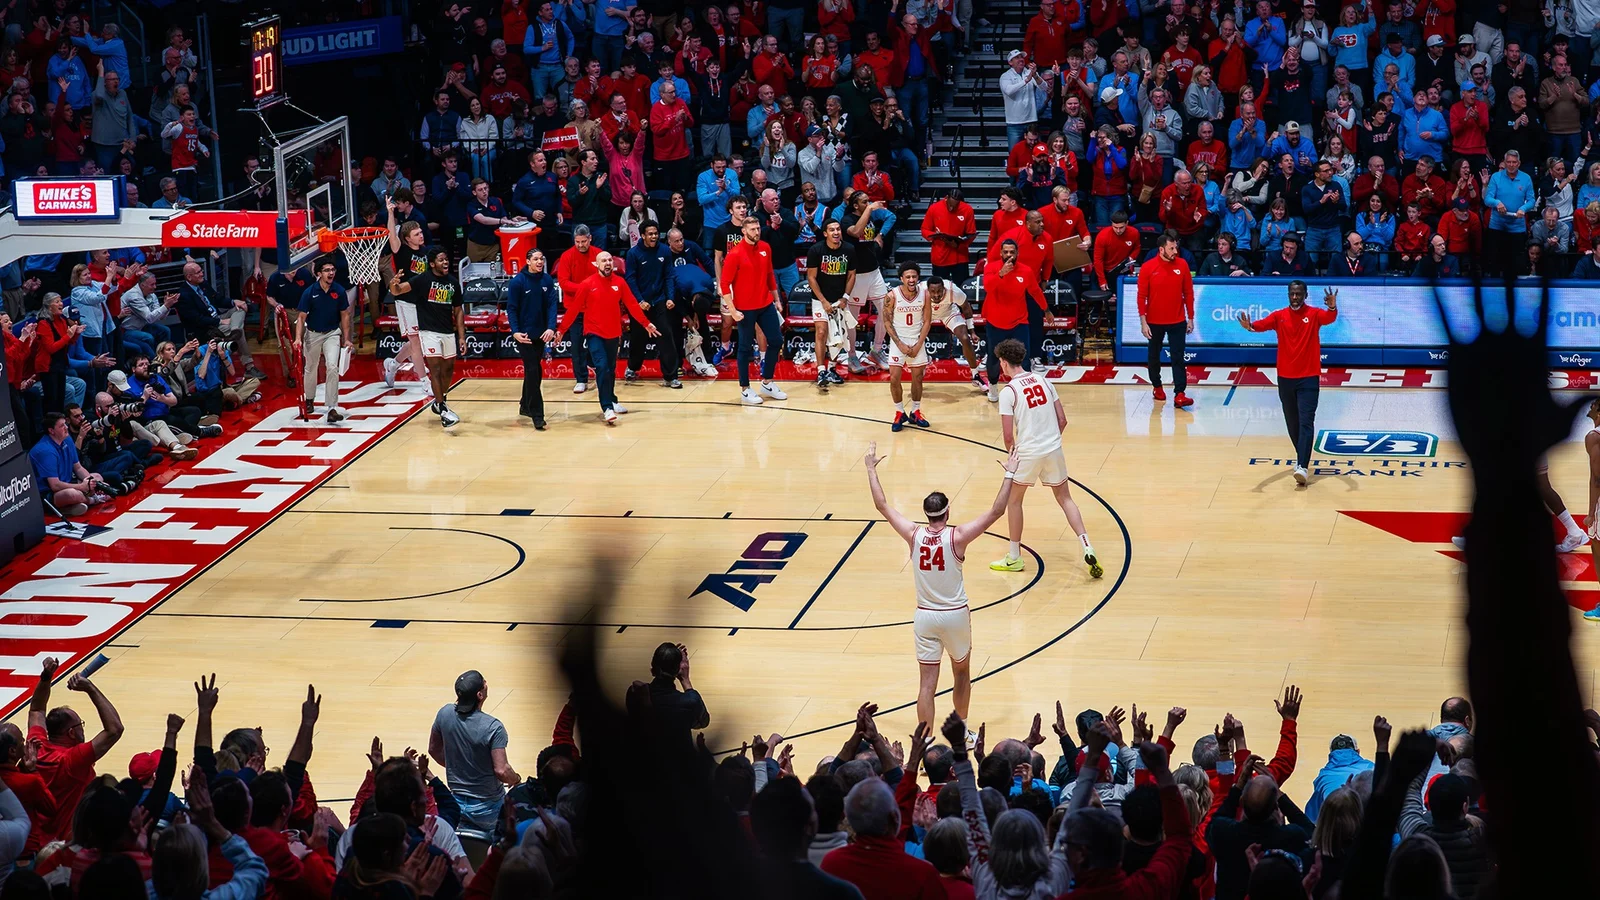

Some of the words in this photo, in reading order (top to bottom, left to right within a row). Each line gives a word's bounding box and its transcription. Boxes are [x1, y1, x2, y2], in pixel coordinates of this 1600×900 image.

[282, 37, 315, 56] BUD
[318, 29, 376, 51] LIGHT
[254, 52, 273, 96] 30
[187, 139, 197, 152] 15
[39, 185, 92, 201] MIKE'S
[727, 234, 743, 242] Bla
[822, 254, 848, 263] Black
[431, 281, 455, 292] Black
[906, 313, 914, 326] 0
[1212, 304, 1275, 322] altafib
[379, 335, 406, 354] Krog
[465, 335, 494, 354] roger
[787, 335, 816, 353] Kroge
[925, 336, 947, 354] oger
[1569, 354, 1592, 367] Kroger
[1019, 376, 1038, 387] LETANG
[1023, 384, 1048, 409] 29
[1335, 434, 1419, 453] 5/3
[81, 380, 434, 547] FLYERS
[1373, 458, 1468, 469] THIR
[1313, 468, 1424, 477] BANK
[921, 535, 942, 546] CONNER
[919, 546, 945, 571] 24
